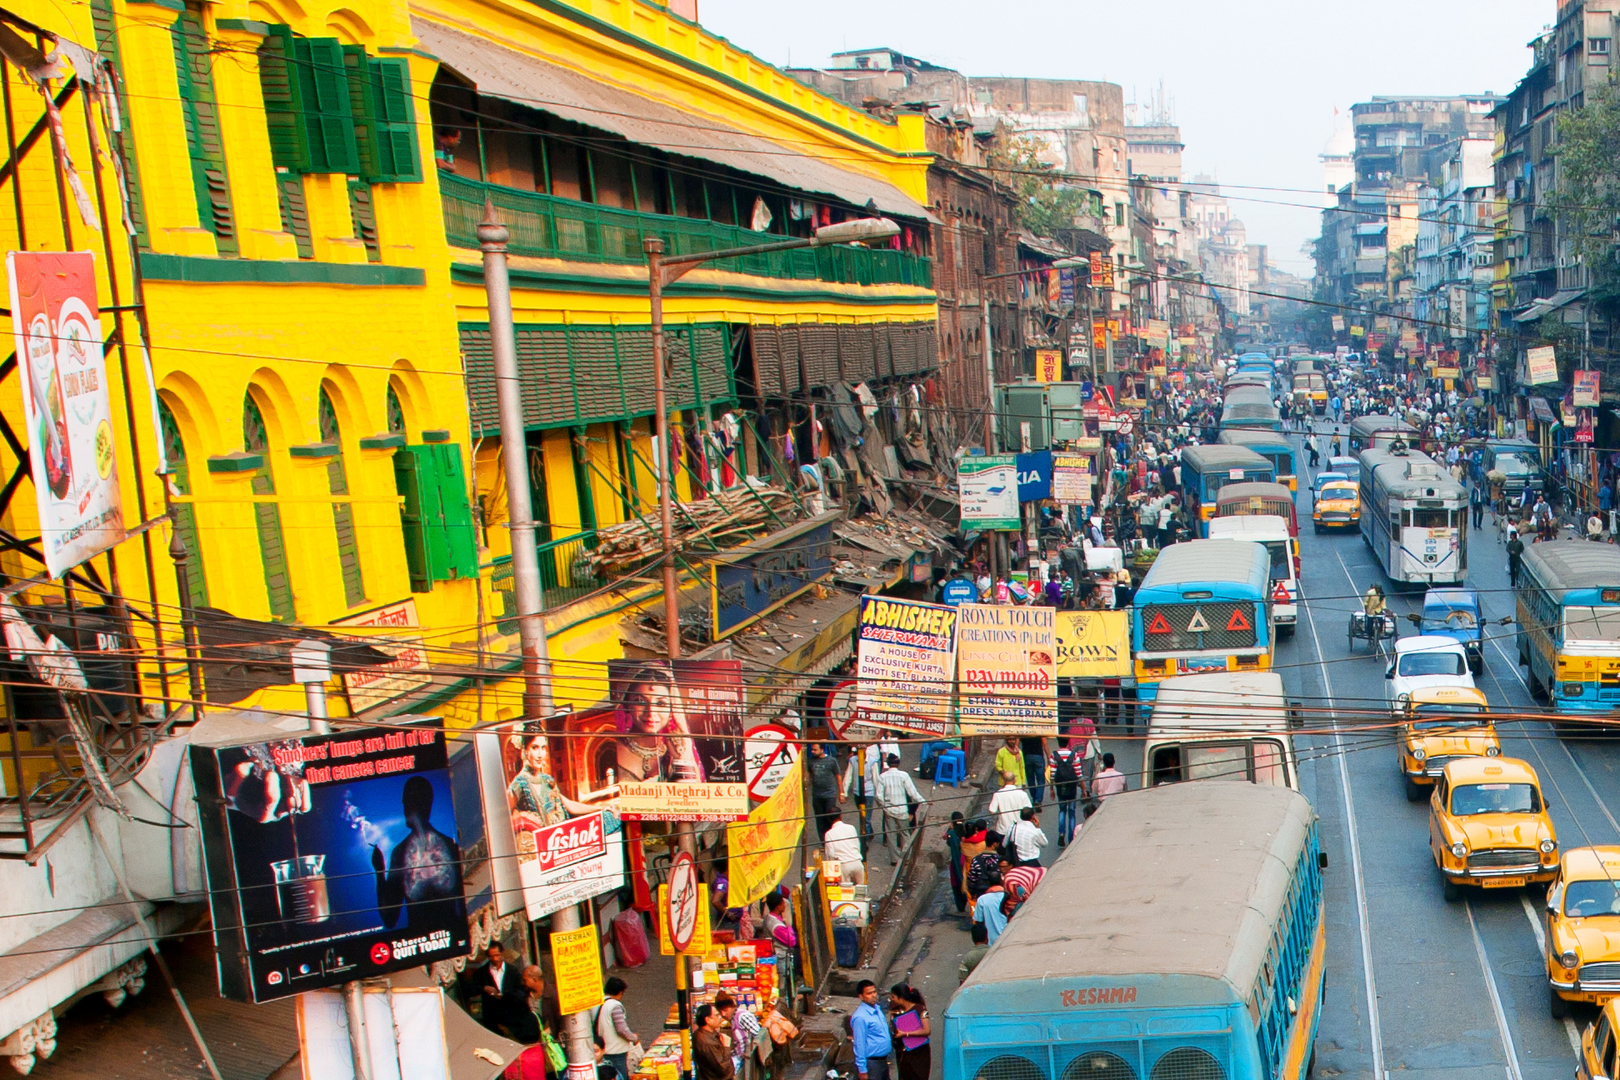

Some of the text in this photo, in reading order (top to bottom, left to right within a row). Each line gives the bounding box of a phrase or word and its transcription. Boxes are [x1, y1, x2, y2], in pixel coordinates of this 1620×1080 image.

[862, 600, 956, 638] ABHISHEK
[961, 608, 1053, 627] ROYAL TOUCH
[862, 627, 948, 649] SHERWANI
[961, 629, 1017, 643] CREATIONS
[1019, 630, 1032, 645] (P)
[888, 648, 918, 659] HOUSE
[920, 651, 932, 660] OF
[862, 666, 888, 677] DHOTI
[864, 656, 945, 675] EXCLUSIVE KURTA,
[881, 680, 888, 688] &
[890, 680, 918, 691] PARTY
[968, 697, 1047, 707] ETHNIC WEAR &
[963, 707, 1054, 719] DRESS MATERIALS
[273, 729, 436, 765] Smokers' lungs are full of tar
[305, 755, 415, 784] that causes cancer
[618, 784, 745, 799] Madanji Meghraj & Co.
[540, 820, 599, 864] Ashok
[578, 861, 603, 878] Young
[391, 936, 427, 949] Tobacco
[429, 929, 451, 941] Kills
[392, 937, 451, 960] QUIT TODAY
[1060, 987, 1137, 1007] RESHMA
